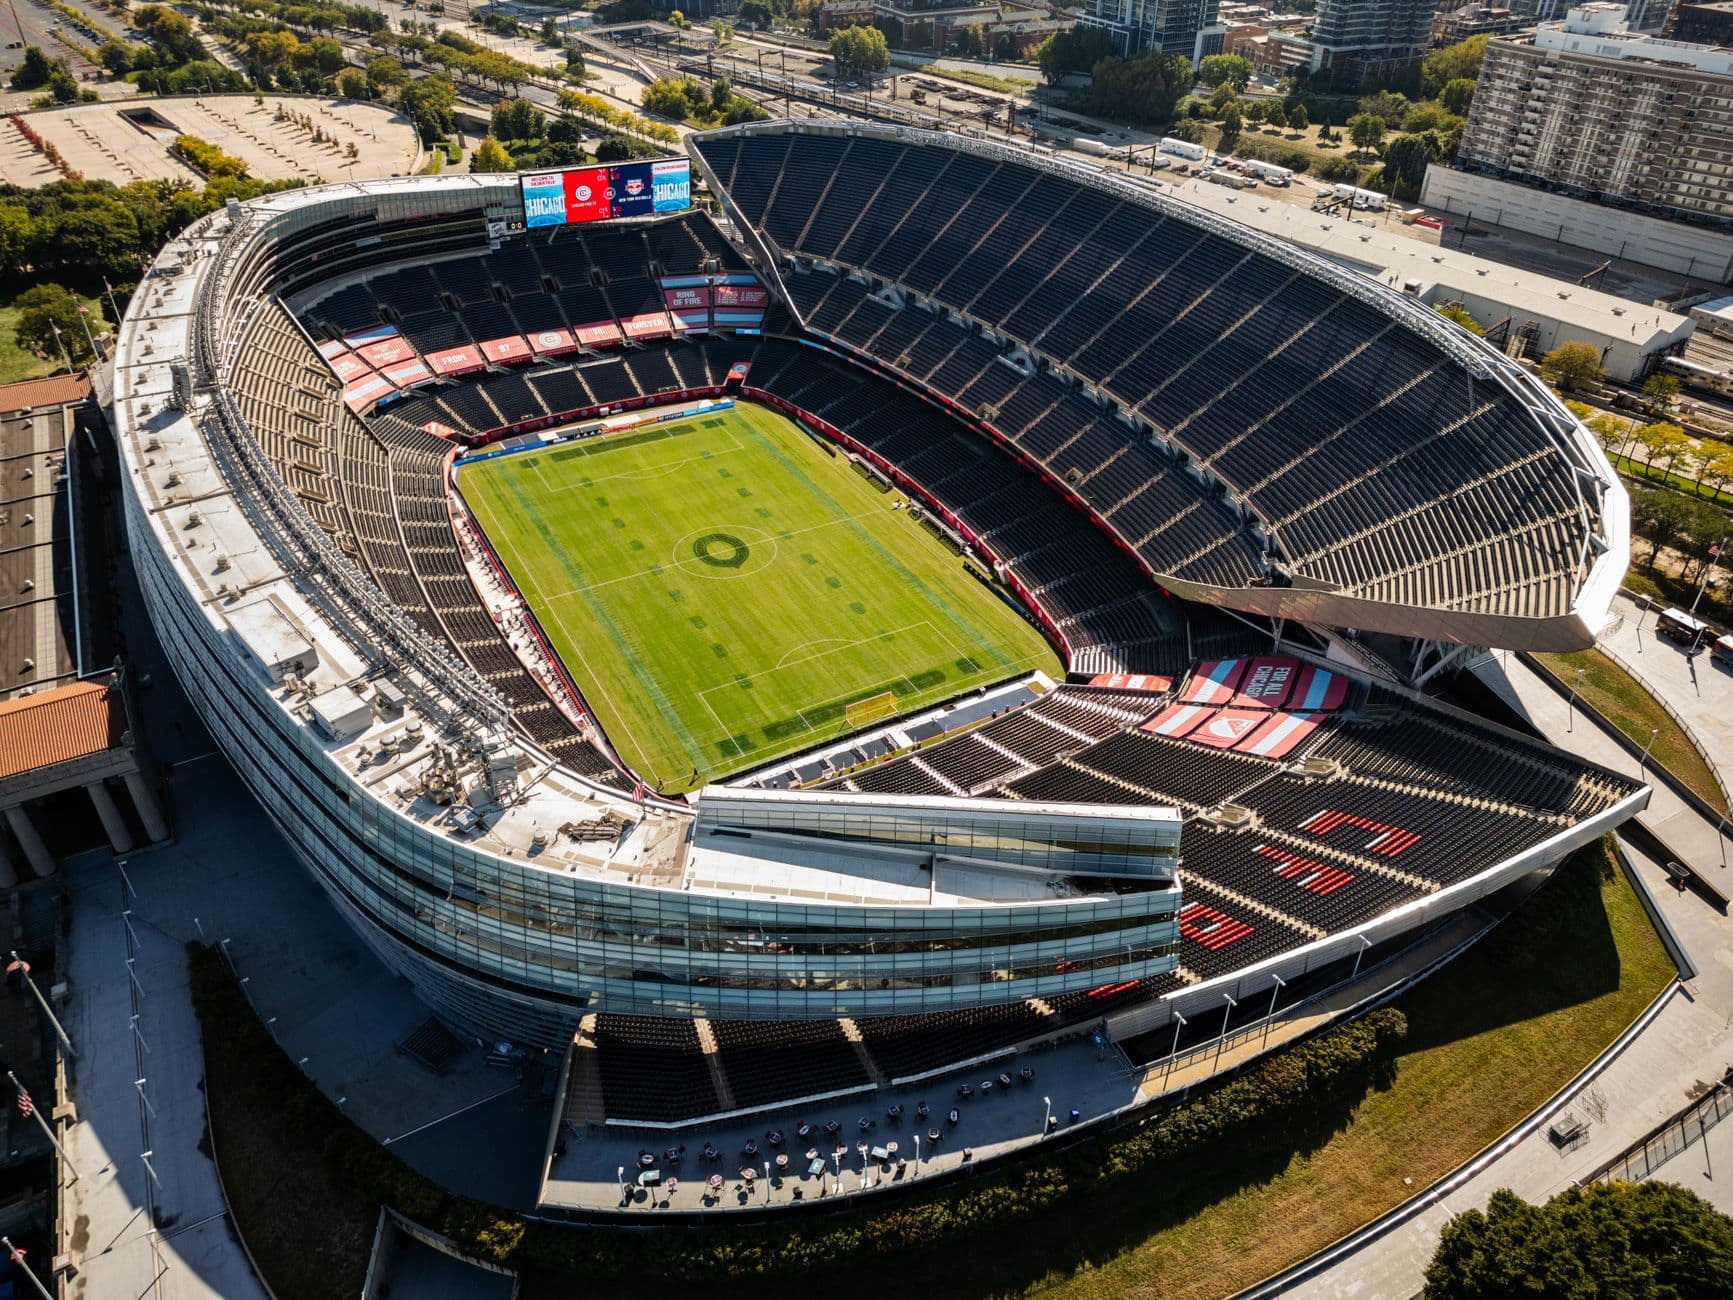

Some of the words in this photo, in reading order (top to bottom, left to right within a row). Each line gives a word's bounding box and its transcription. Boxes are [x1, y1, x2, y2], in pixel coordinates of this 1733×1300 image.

[652, 181, 689, 202] CHICAGO
[525, 197, 565, 216] CHICAGO
[685, 297, 702, 305] FIRE
[442, 353, 466, 364] FROM
[1244, 665, 1274, 698] CHICAGO
[1270, 666, 1292, 682] FOR
[1262, 681, 1284, 696] ALL
